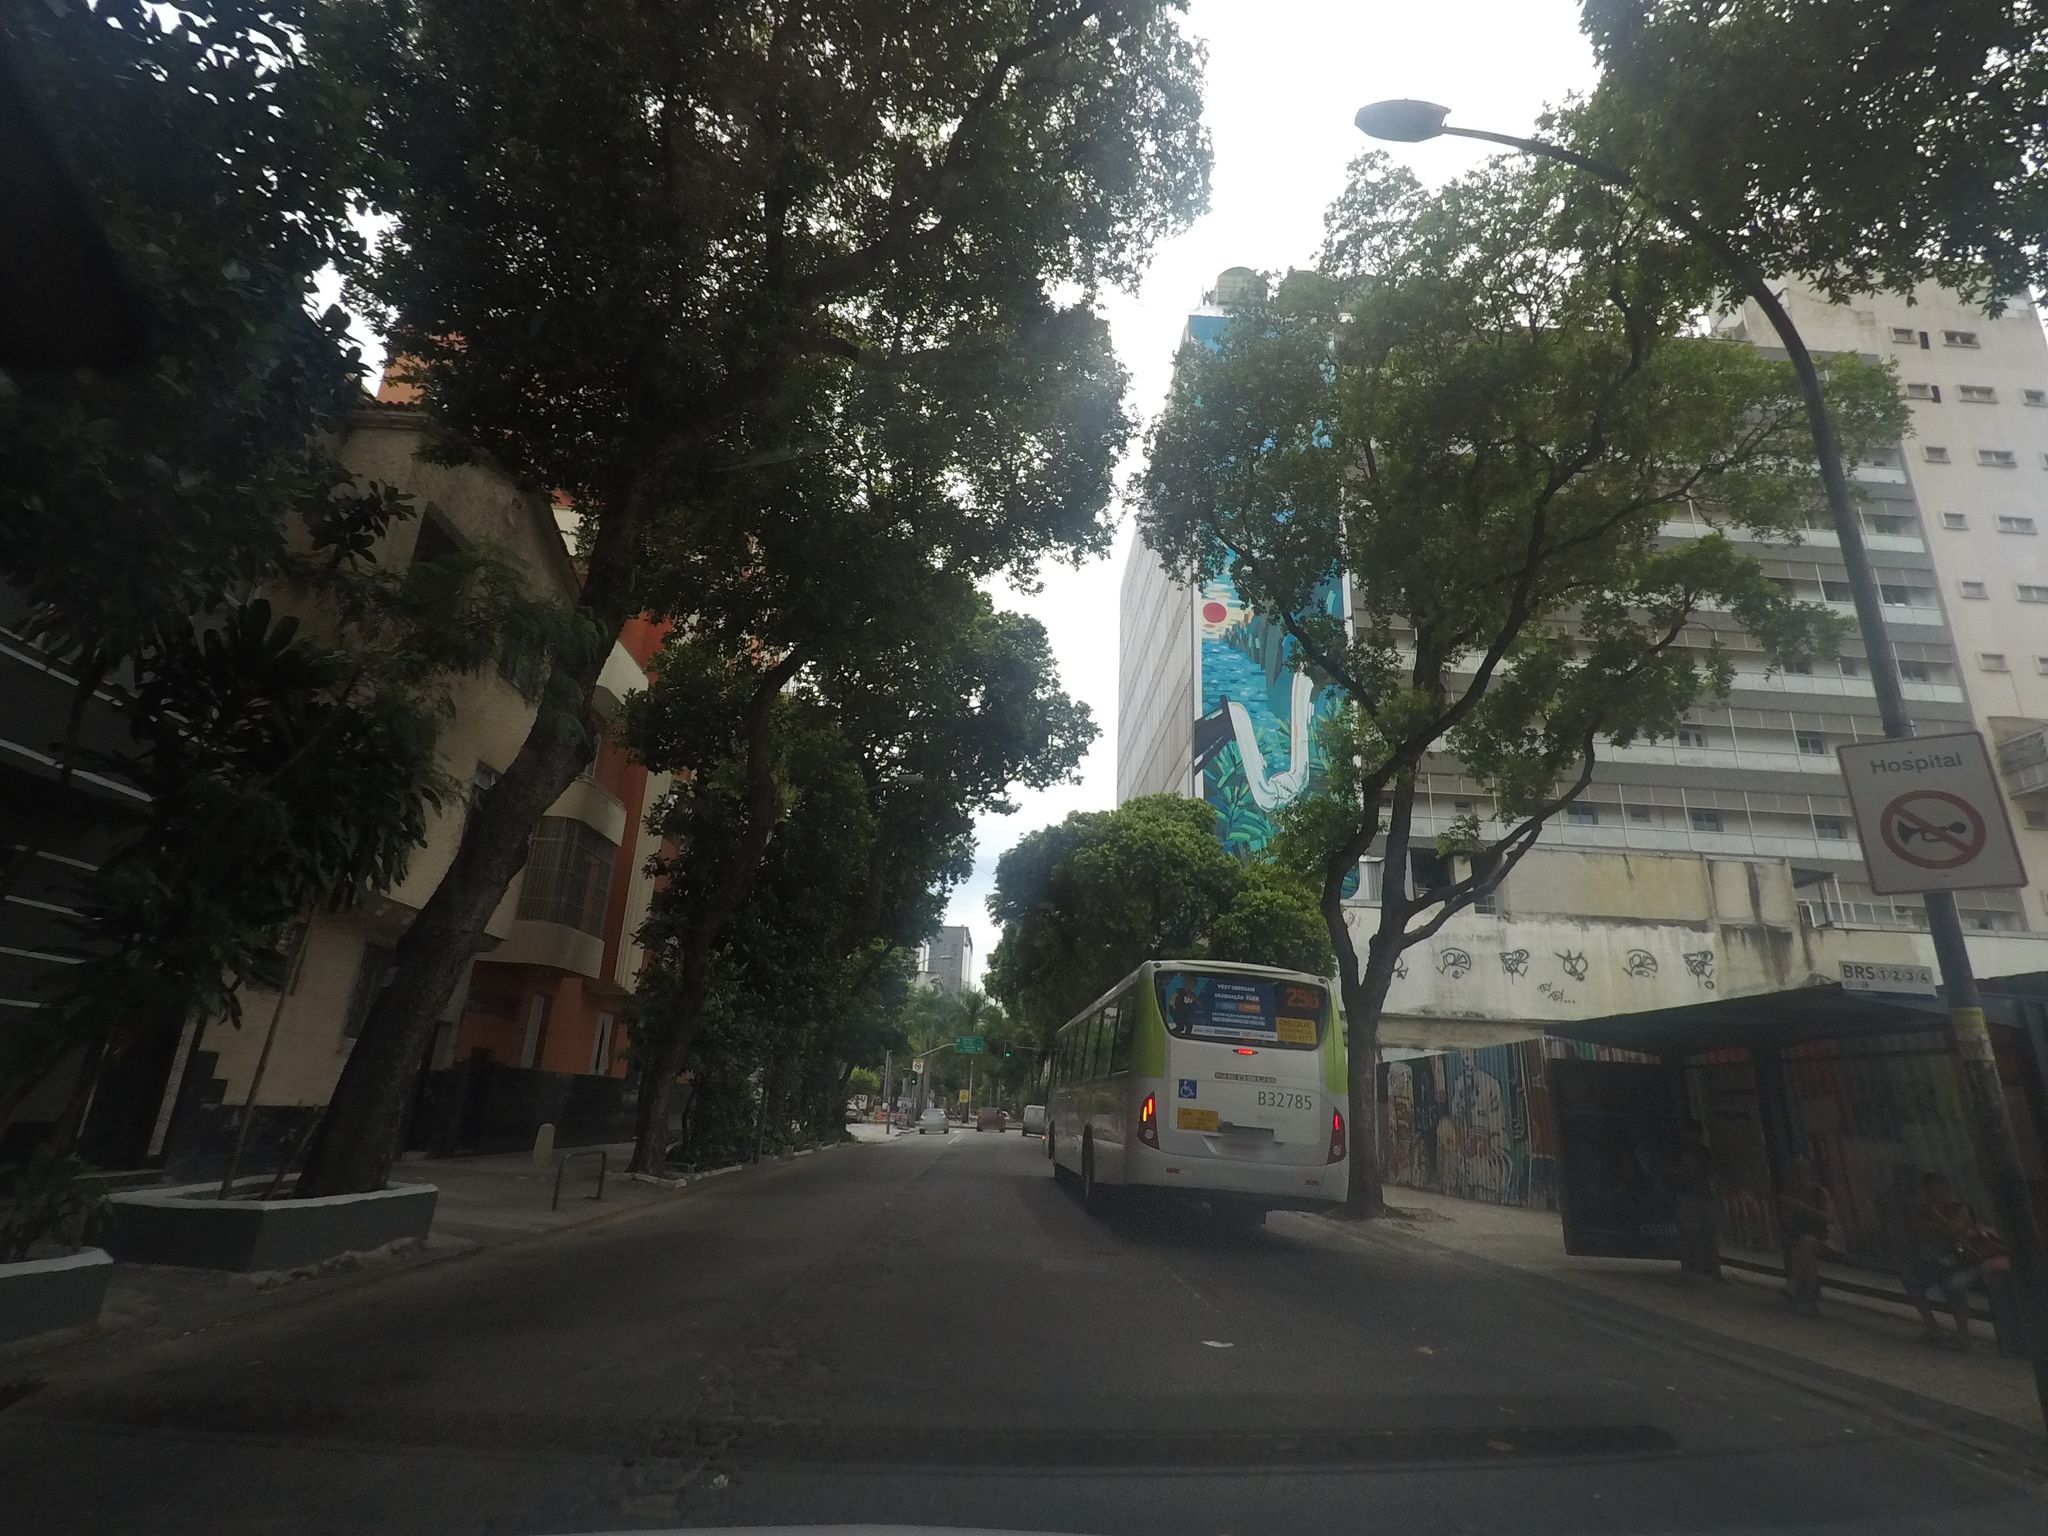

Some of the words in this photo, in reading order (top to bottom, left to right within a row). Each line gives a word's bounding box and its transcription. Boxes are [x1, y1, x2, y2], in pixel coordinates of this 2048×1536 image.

[1870, 752, 1962, 774] Hospital
[1843, 965, 1876, 980] BRS
[1258, 1091, 1312, 1111] B32785
